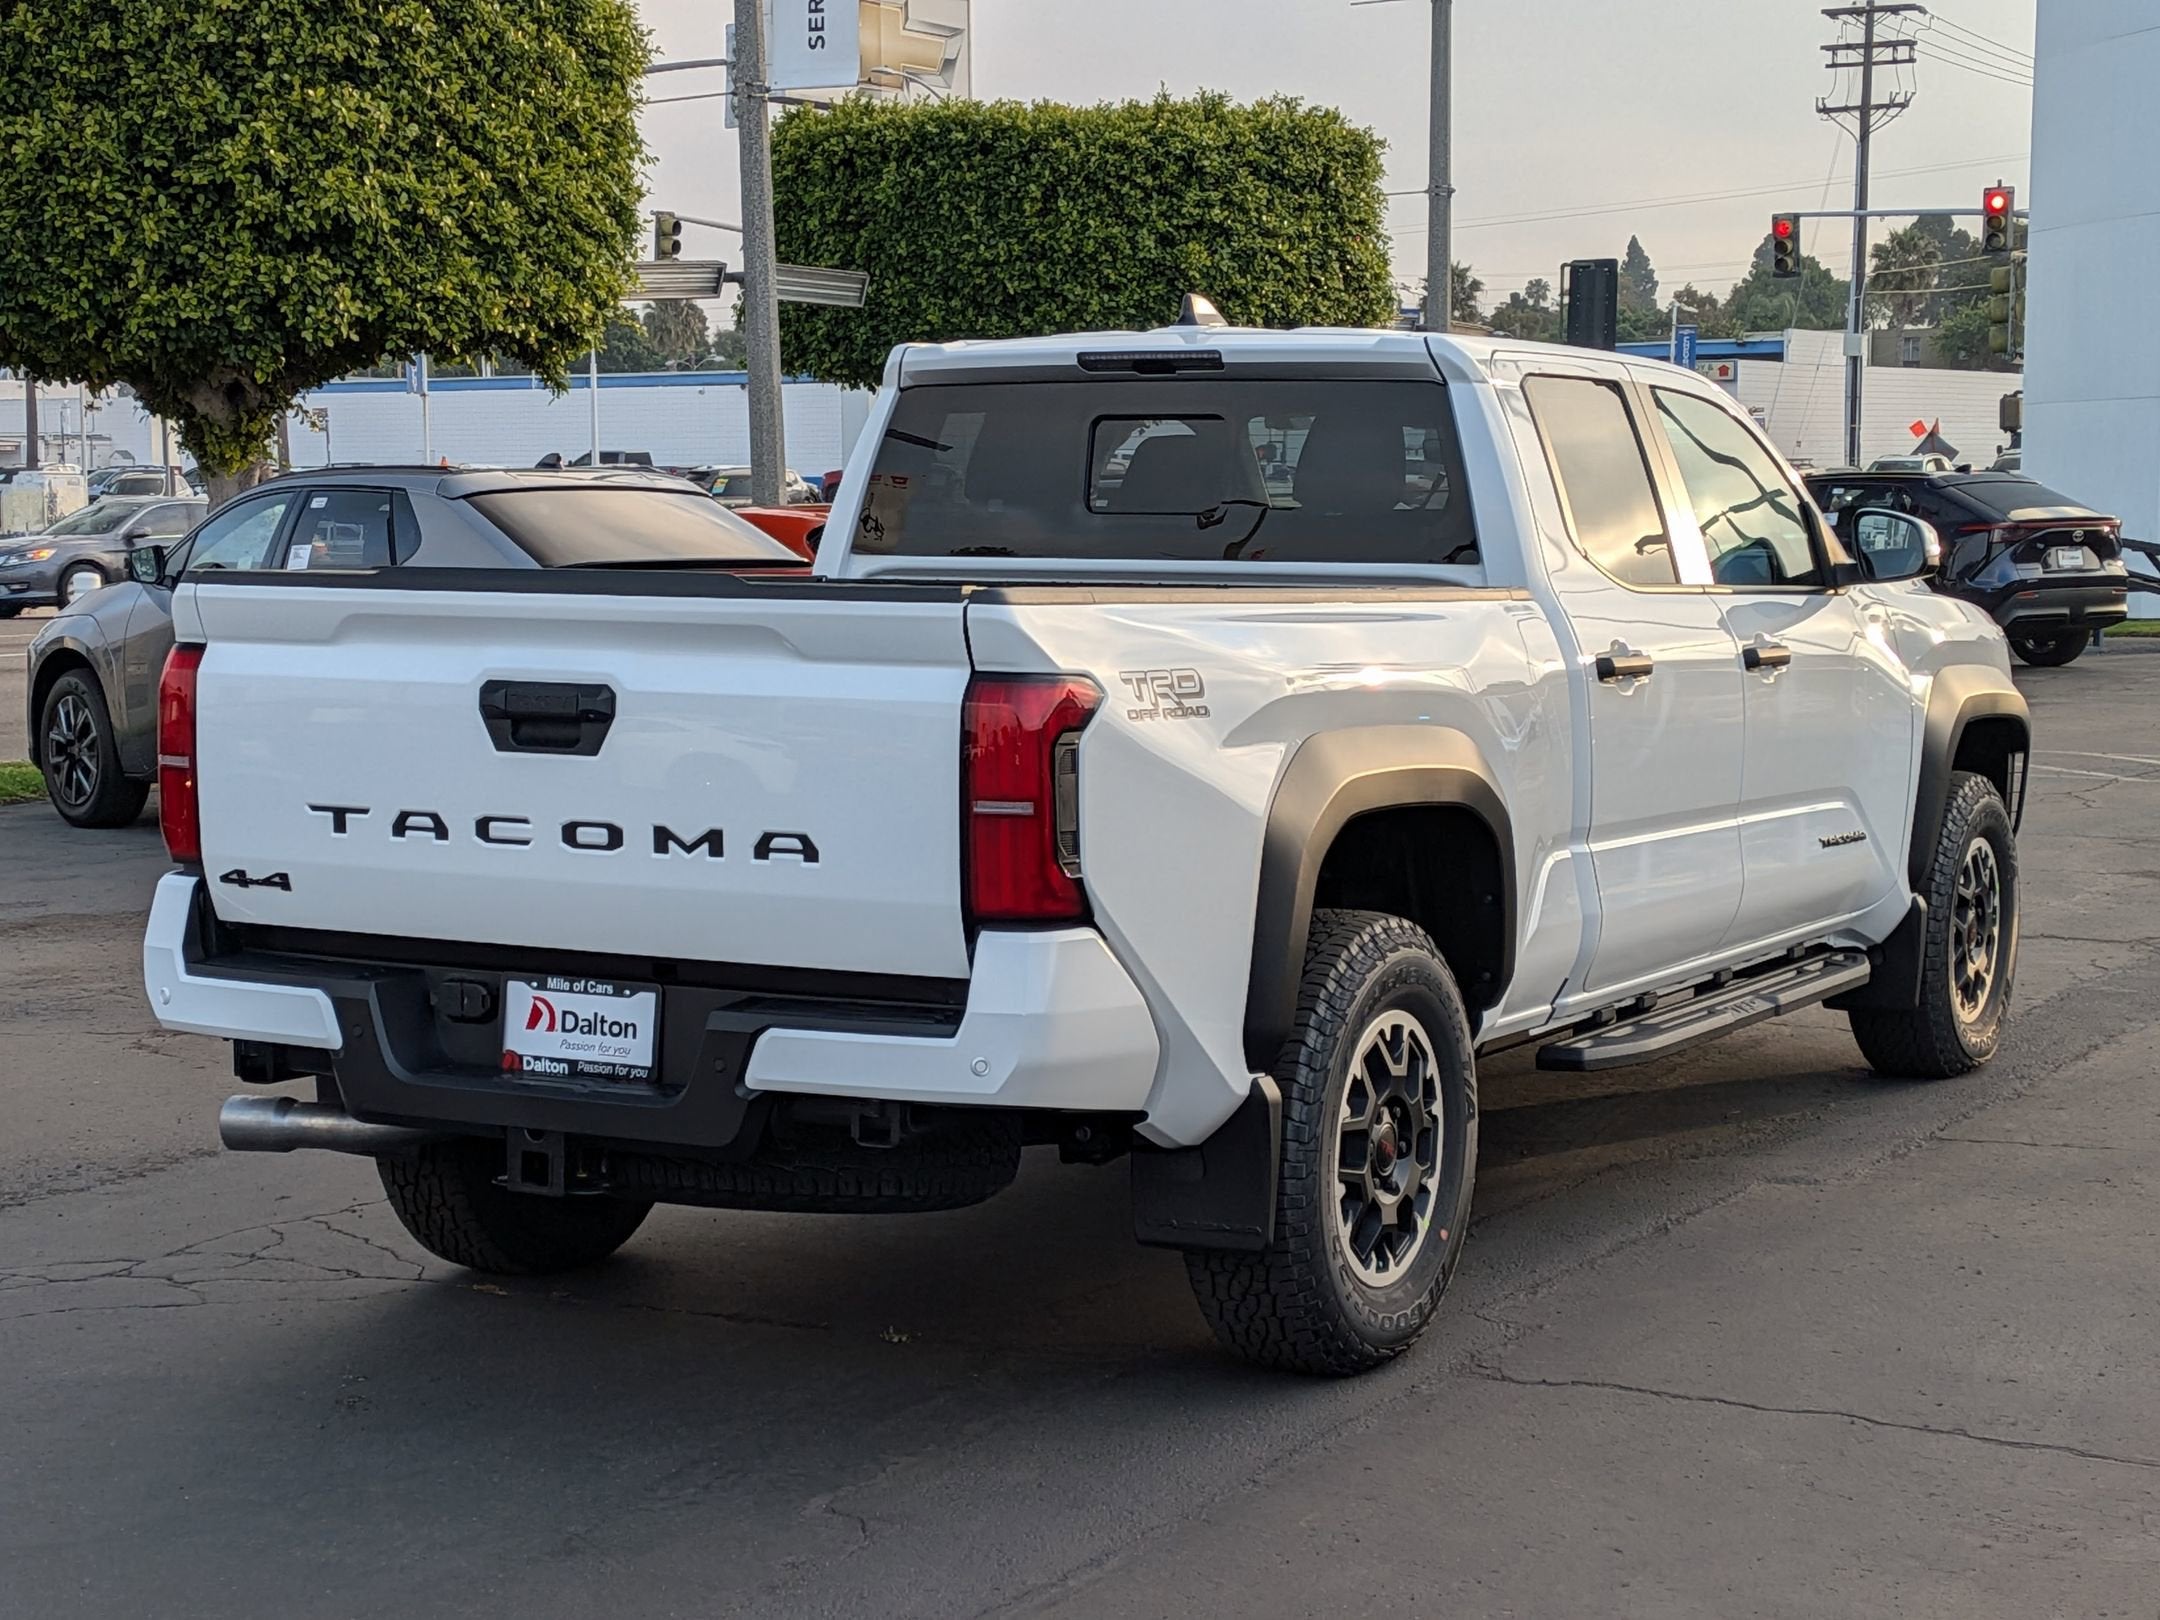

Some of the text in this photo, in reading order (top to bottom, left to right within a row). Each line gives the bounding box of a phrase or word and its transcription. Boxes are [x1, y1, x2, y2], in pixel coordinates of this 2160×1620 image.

[1119, 669, 1205, 708] TRD
[1127, 705, 1211, 722] OFF ROAD
[306, 802, 821, 866] TACOMA
[547, 976, 614, 994] Mile of Cars
[561, 1010, 637, 1040] Dalton
[560, 1039, 632, 1056] Passion for you
[522, 1056, 649, 1079] Dalton Passion for you
